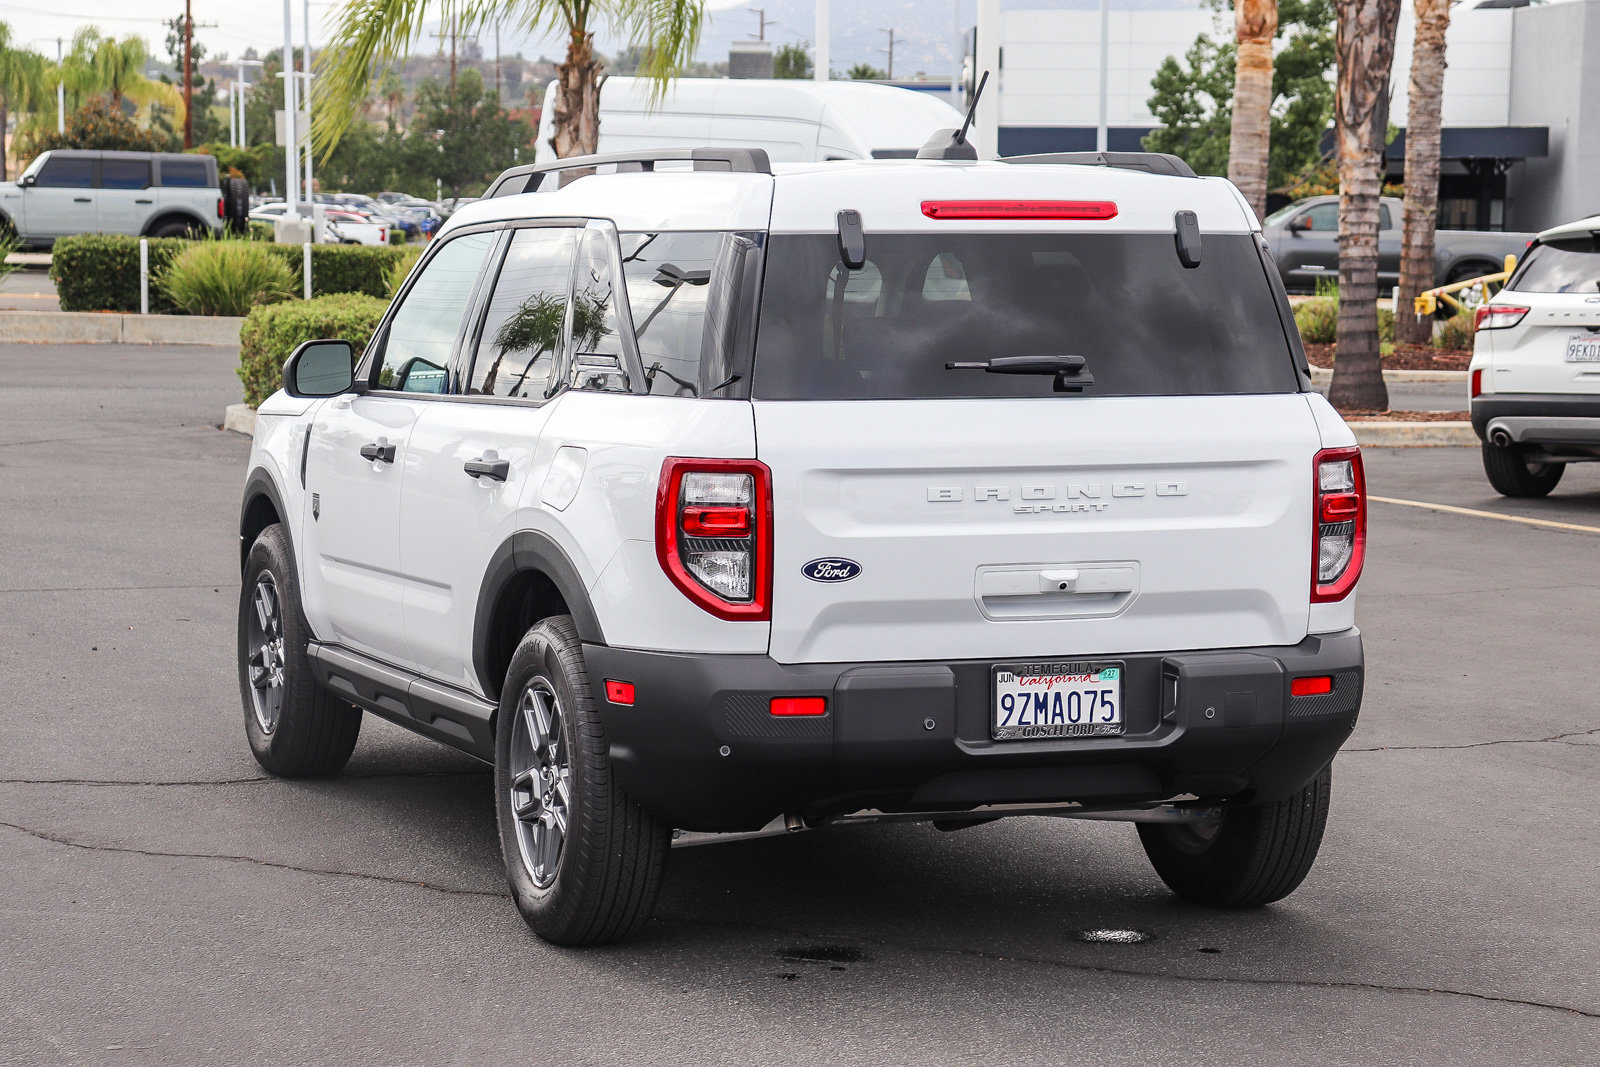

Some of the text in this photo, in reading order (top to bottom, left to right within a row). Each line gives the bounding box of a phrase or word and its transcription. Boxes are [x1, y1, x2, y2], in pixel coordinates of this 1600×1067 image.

[927, 481, 1190, 502] BRONCO
[1013, 502, 1108, 514] SPORT
[1024, 663, 1093, 676] TEMECULA
[998, 674, 1015, 684] JUN
[1020, 674, 1100, 690] California
[1000, 690, 1115, 727] 9ZMA075
[1066, 724, 1095, 736] FORD
